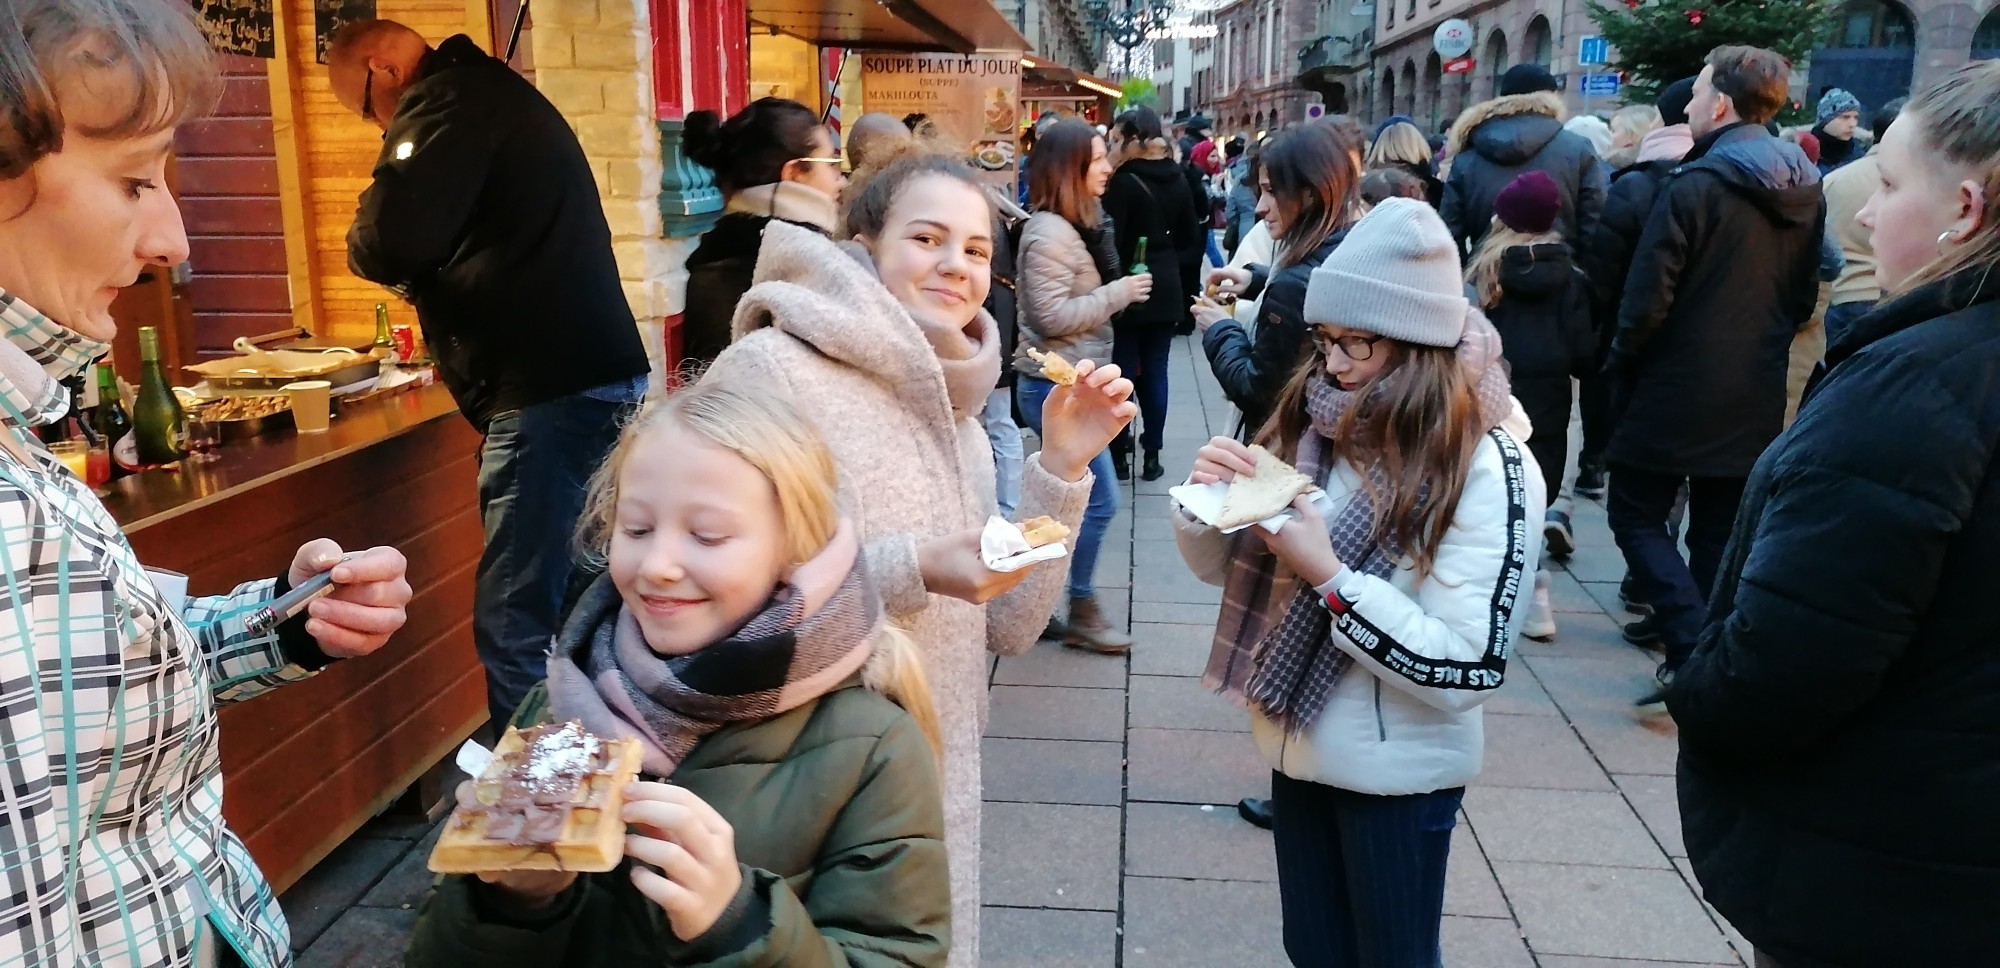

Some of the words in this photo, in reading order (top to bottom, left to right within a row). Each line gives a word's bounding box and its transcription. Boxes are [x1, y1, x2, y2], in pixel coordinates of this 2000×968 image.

[865, 57, 914, 74] SOUPE
[918, 58, 955, 74] PLAT
[958, 58, 978, 75] DU
[980, 58, 1018, 77] JOUR
[868, 90, 938, 100] MAKHLOUTA
[919, 77, 960, 88] (SUPPE)
[1512, 519, 1526, 564] GIRLS
[1498, 567, 1520, 610] RULE
[1339, 612, 1380, 650] GIRLS
